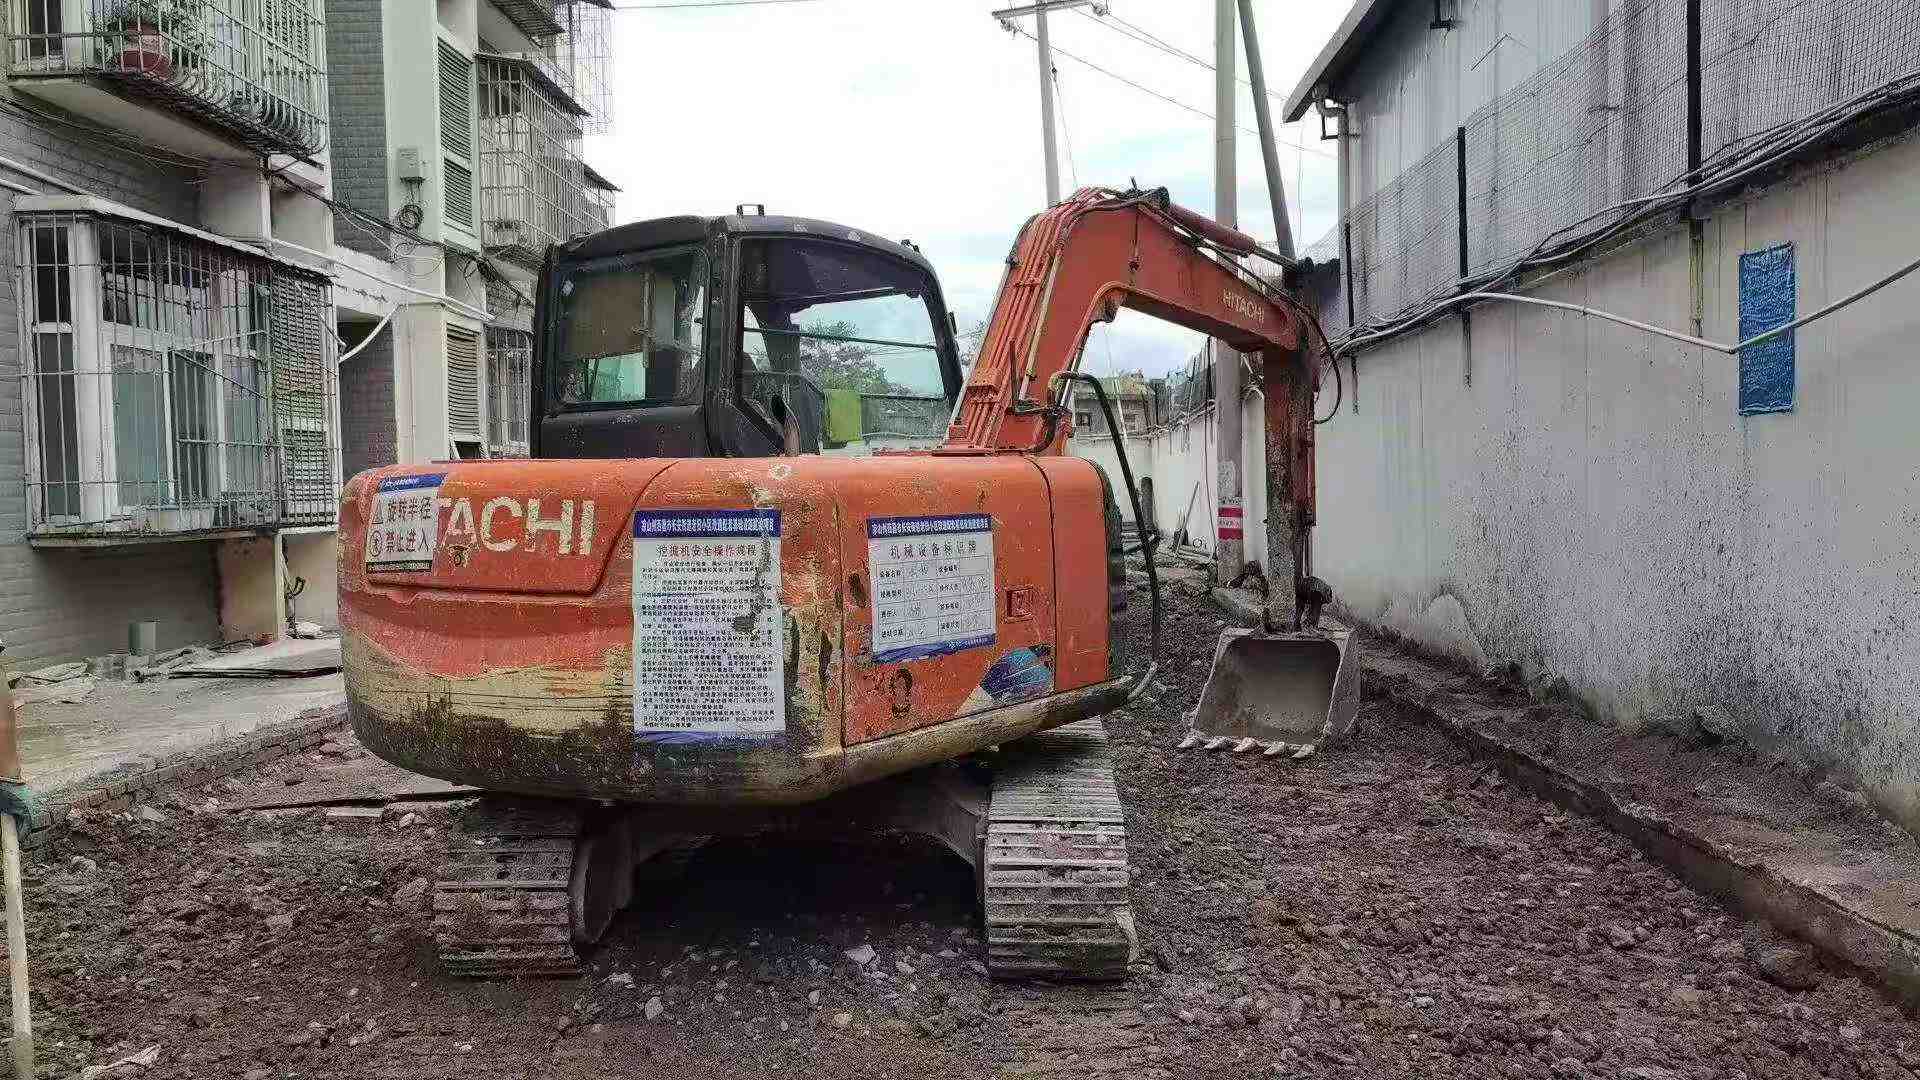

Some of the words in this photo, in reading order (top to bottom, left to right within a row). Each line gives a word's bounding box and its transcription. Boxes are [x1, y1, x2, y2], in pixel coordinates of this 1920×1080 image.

[1223, 287, 1265, 324] HITACHI
[387, 496, 432, 522] 旋转半径
[385, 528, 429, 552] 禁止进入
